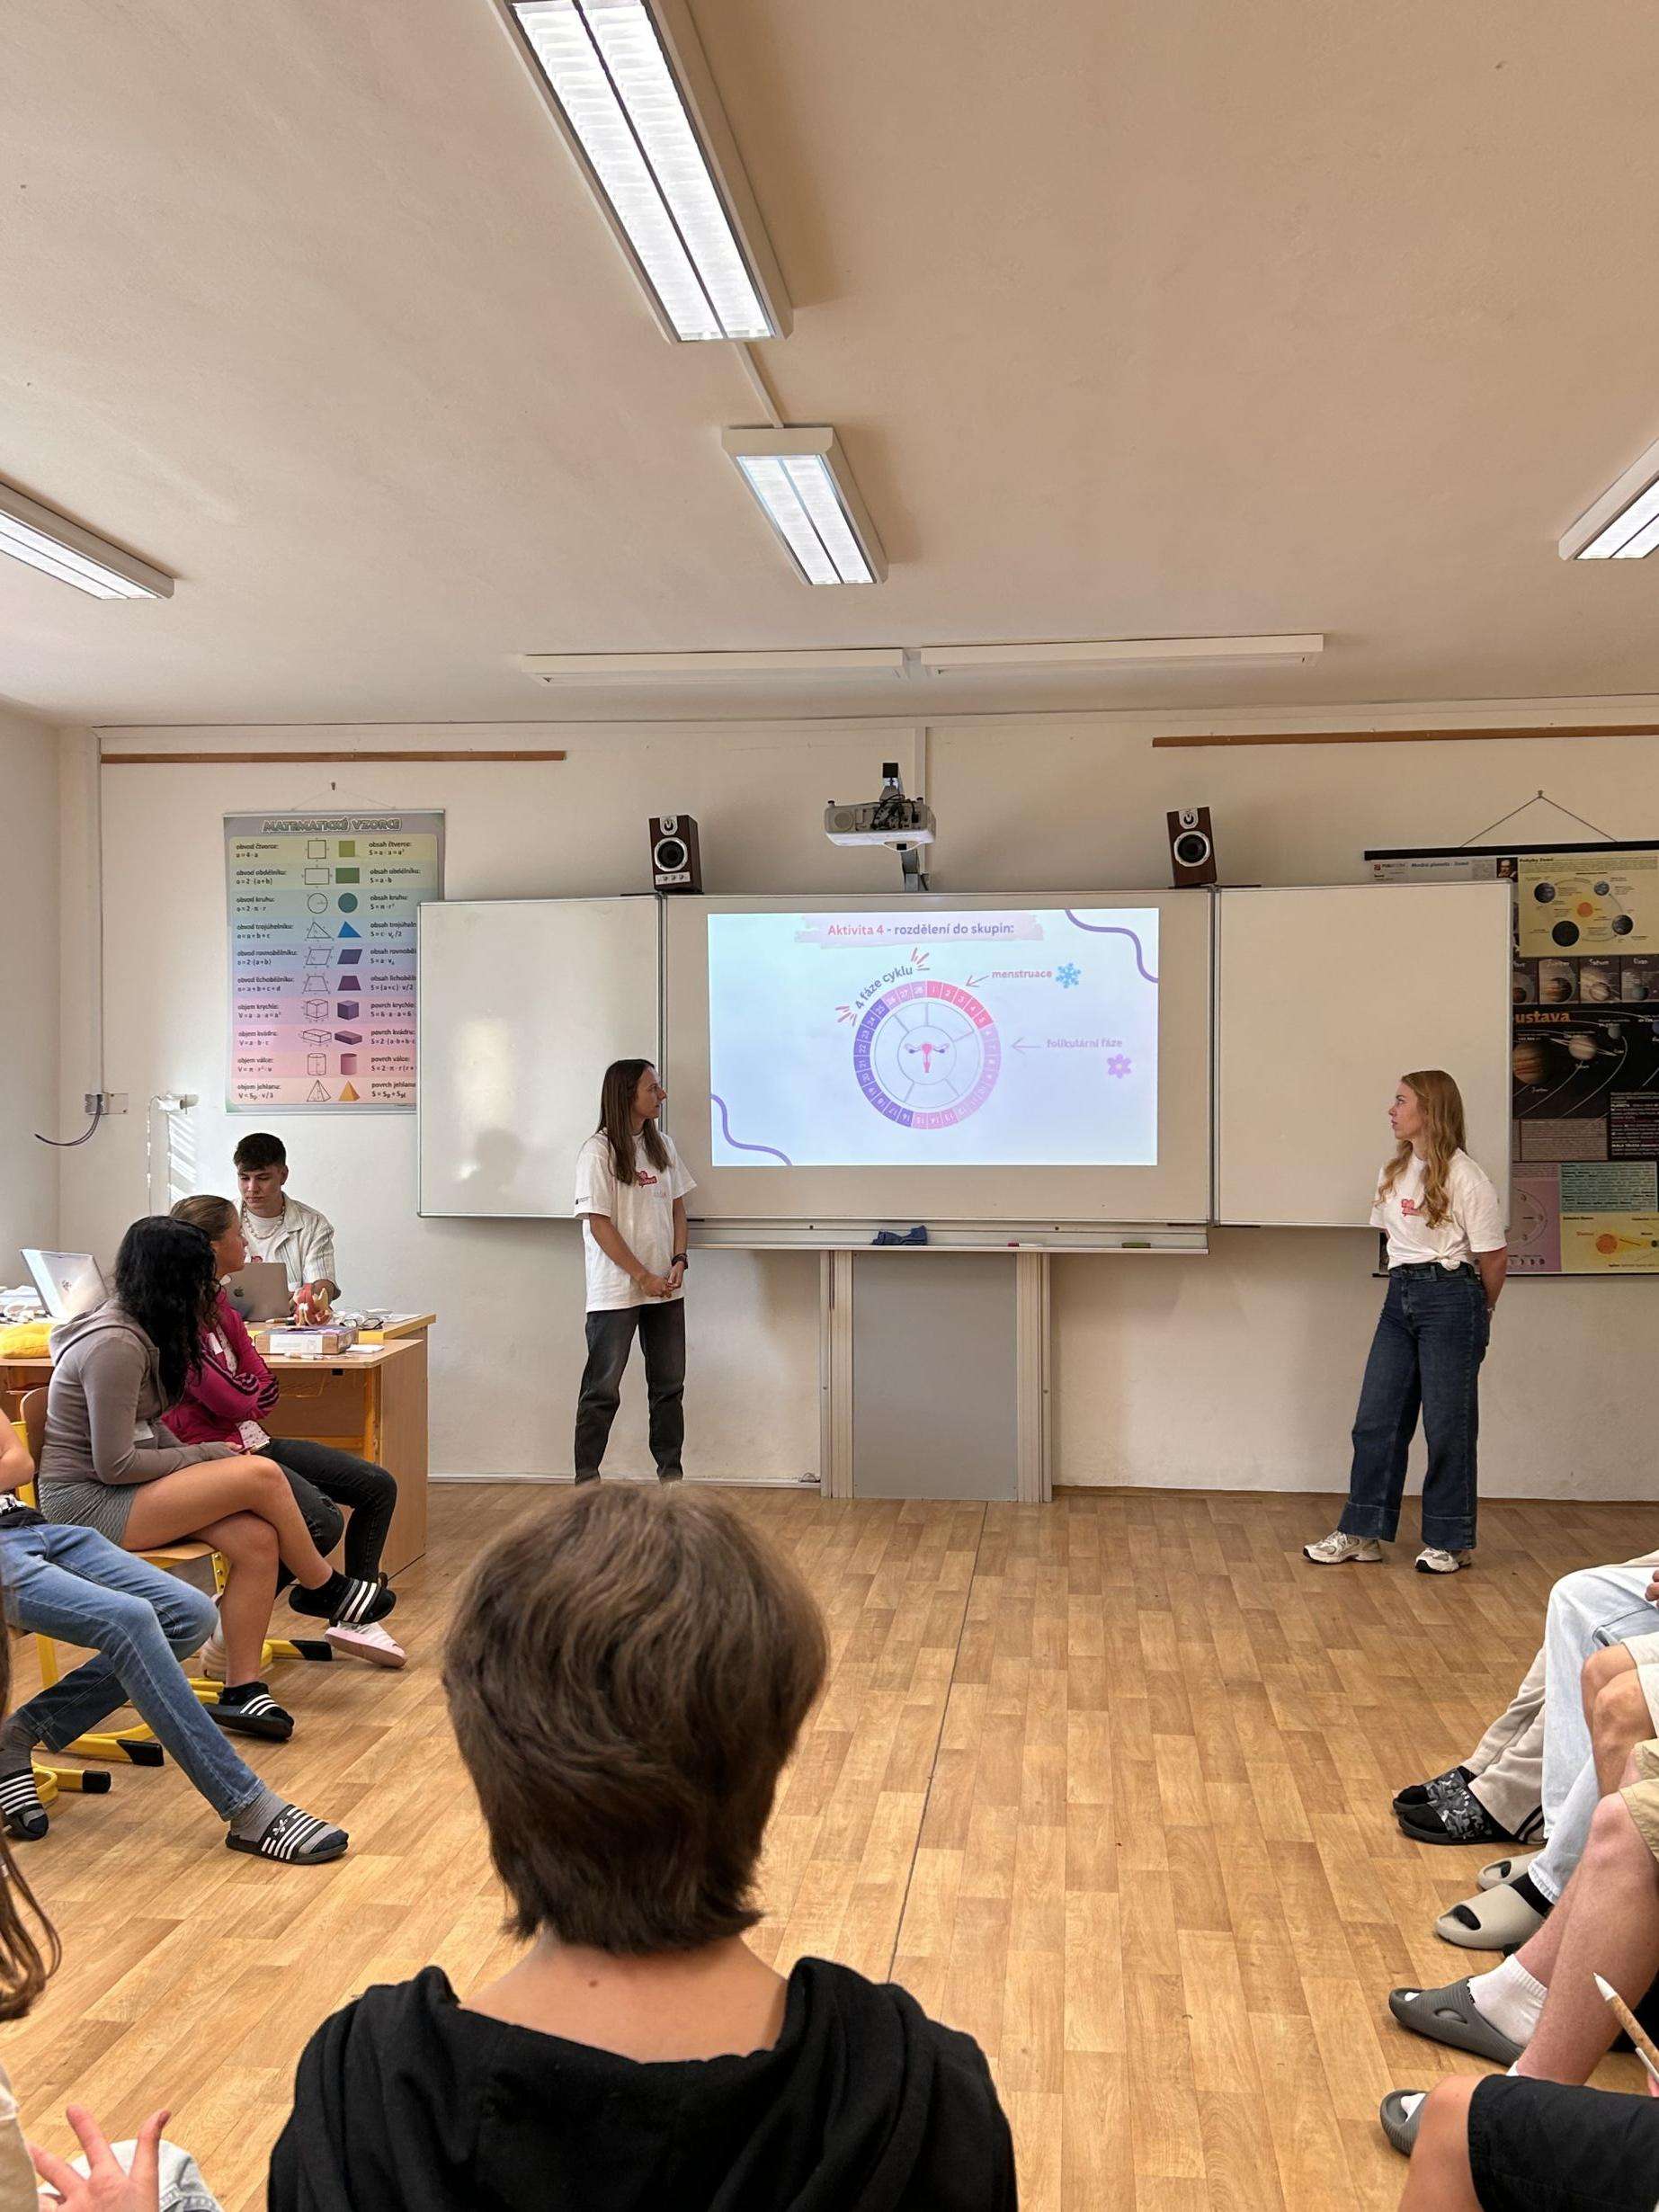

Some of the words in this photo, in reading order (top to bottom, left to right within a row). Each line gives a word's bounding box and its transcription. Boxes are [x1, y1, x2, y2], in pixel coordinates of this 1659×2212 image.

[262, 816, 349, 833] MATEMATICKÉ
[351, 818, 401, 831] VZORCE
[827, 924, 874, 935] Aktivita
[876, 924, 884, 934] 4
[894, 923, 950, 935] rozdělení
[953, 923, 968, 934] do
[971, 923, 1014, 937] skupin:
[992, 969, 1053, 978] menstruace
[855, 1000, 864, 1010] 4
[860, 979, 881, 1000] fáze
[882, 966, 913, 984] cyklu
[1514, 1011, 1570, 1023] ustava
[1047, 1038, 1099, 1048] folikulární
[1101, 1039, 1122, 1048] fáze
